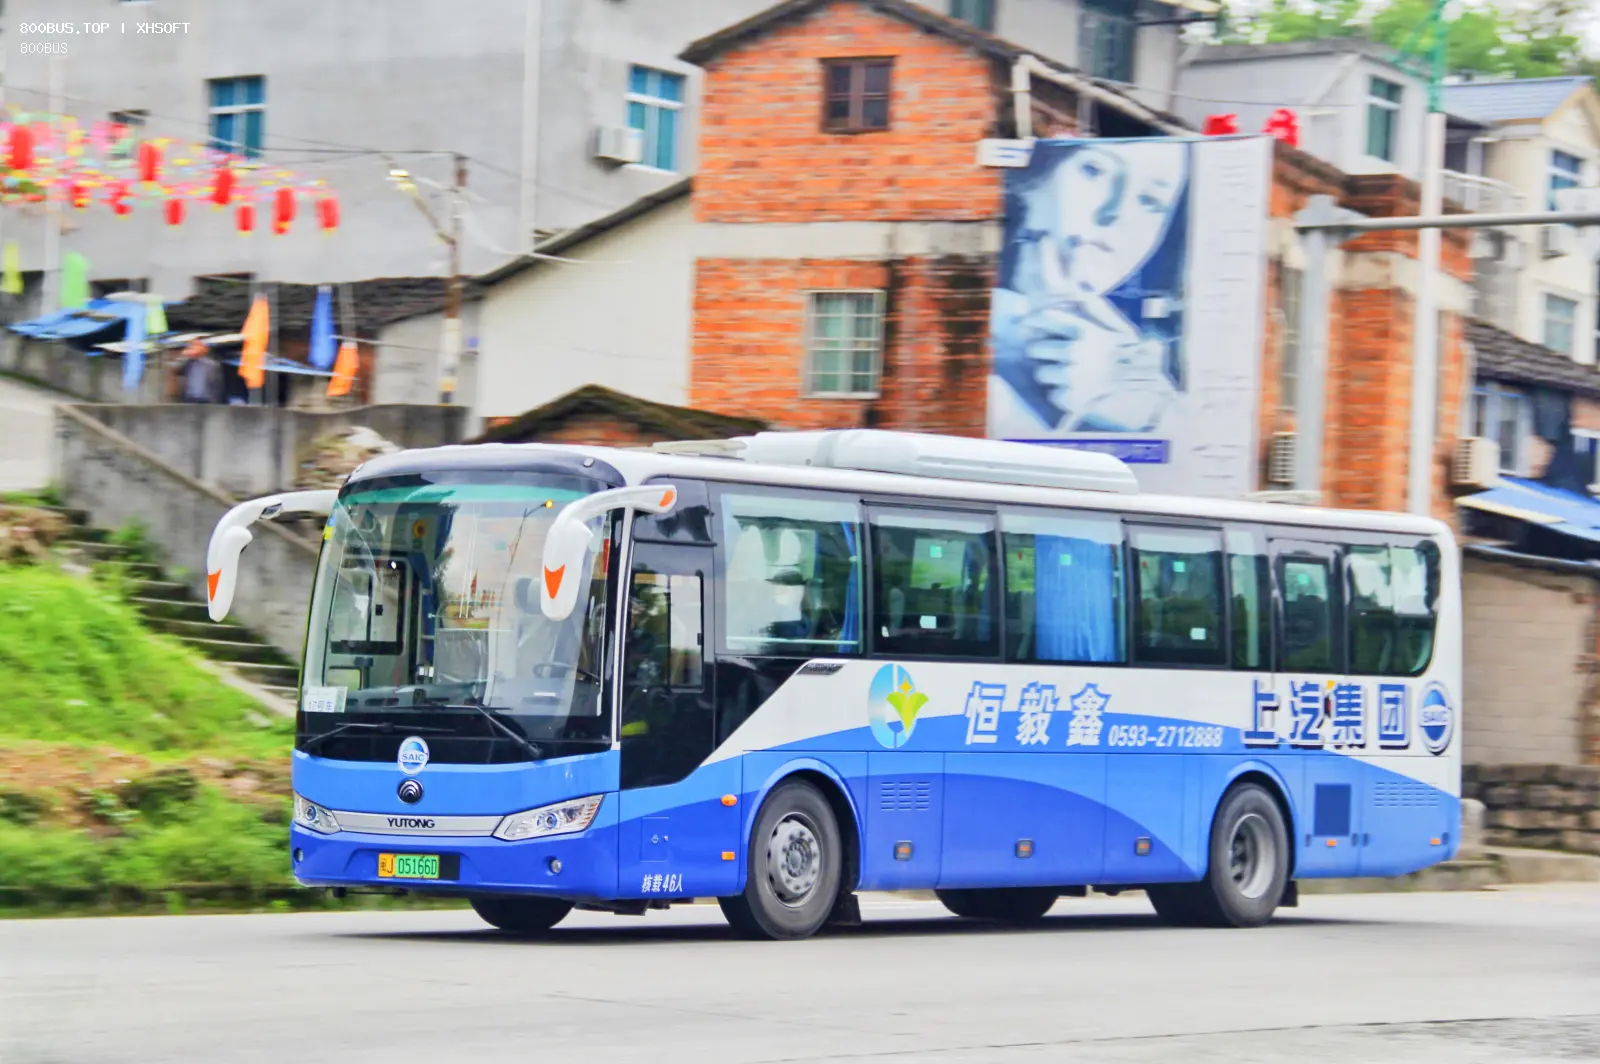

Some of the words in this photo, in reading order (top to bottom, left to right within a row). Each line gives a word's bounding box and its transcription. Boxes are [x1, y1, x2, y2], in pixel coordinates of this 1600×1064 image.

[964, 680, 1112, 746] 恒毅鑫
[1242, 679, 1409, 748] 上汽集团
[1108, 724, 1224, 748] 0593-2712888
[402, 753, 425, 762] SAIC
[387, 818, 435, 828] YUTONG
[641, 873, 683, 893] 核载46人
